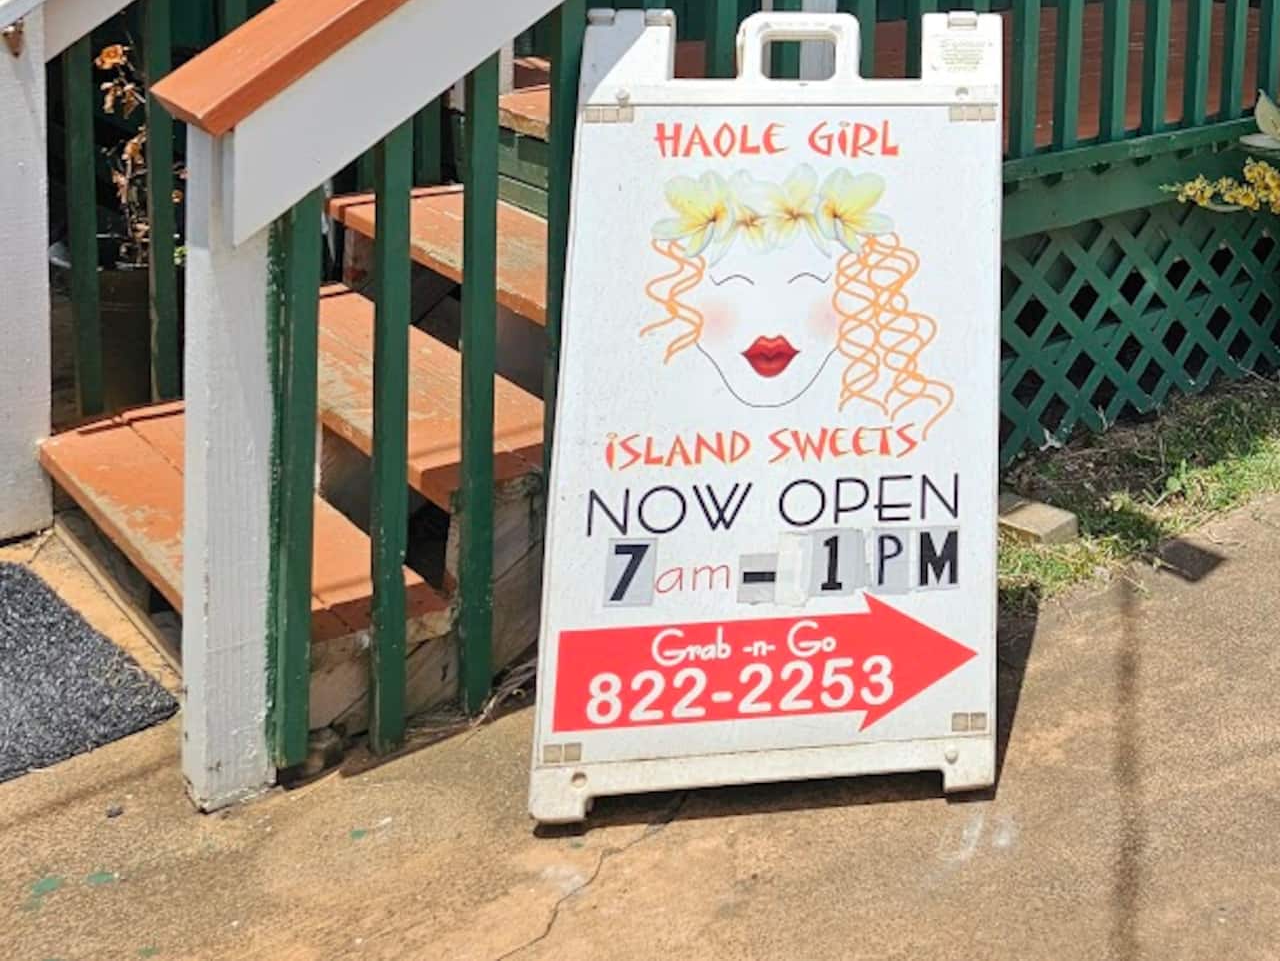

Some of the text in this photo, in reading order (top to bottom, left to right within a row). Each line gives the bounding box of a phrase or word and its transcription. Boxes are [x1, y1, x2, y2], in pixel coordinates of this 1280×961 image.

[653, 121, 790, 159] HAOLE
[767, 422, 918, 464] SWEETS
[585, 473, 960, 537] NOW OPEN
[607, 543, 732, 602] 7am
[651, 626, 732, 667] Grab
[786, 620, 837, 657] Go
[585, 655, 895, 725] 822-2253
